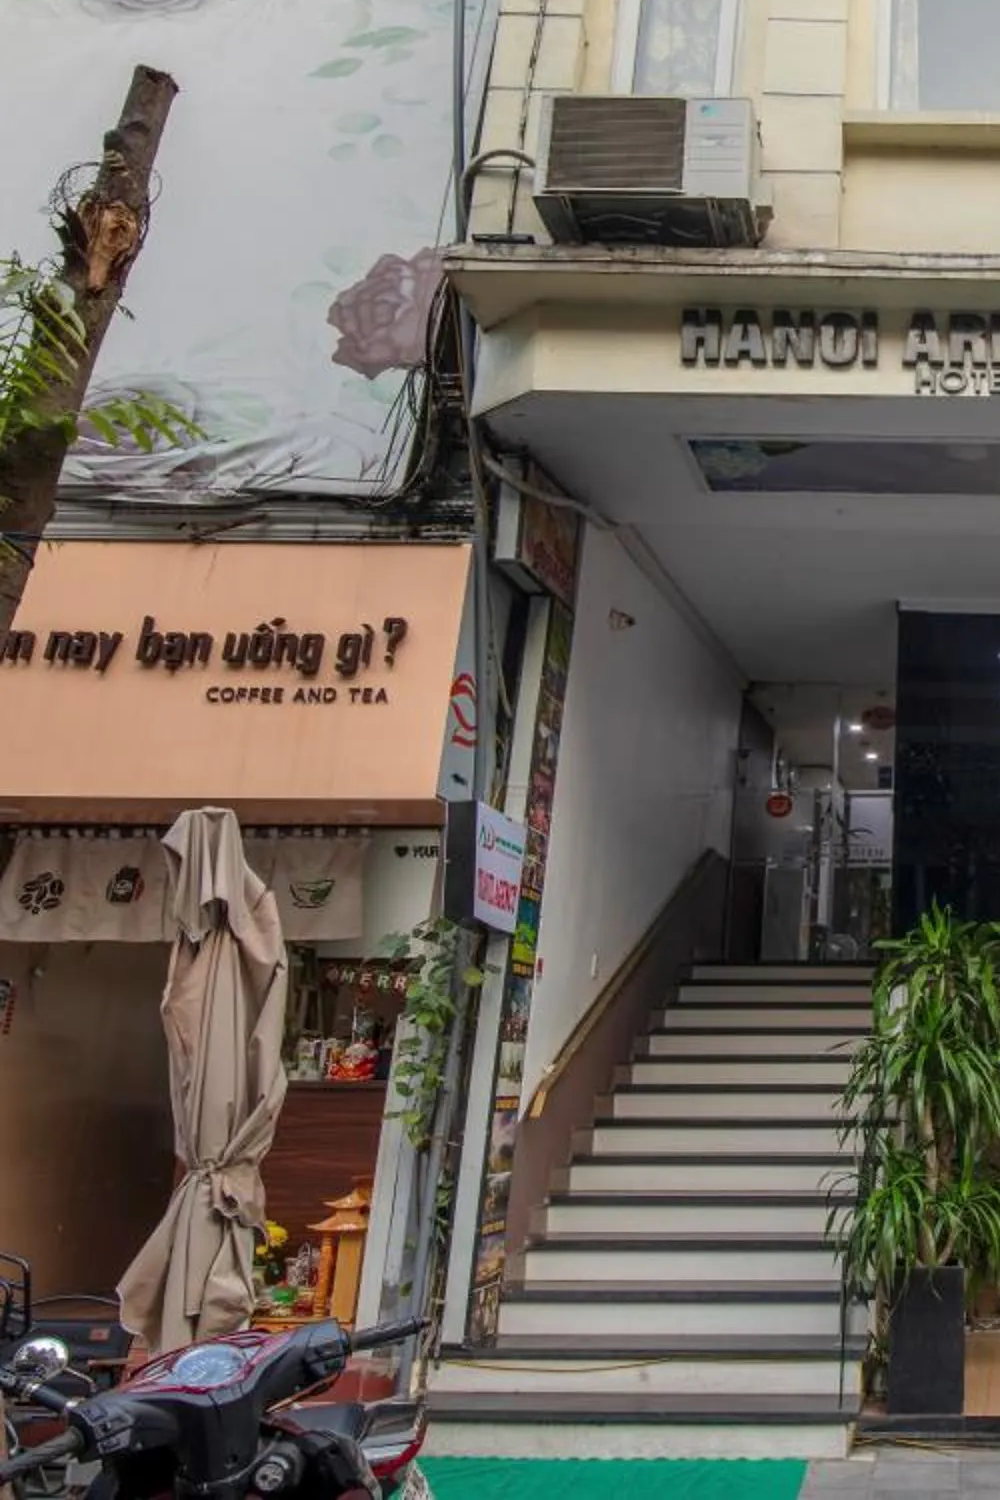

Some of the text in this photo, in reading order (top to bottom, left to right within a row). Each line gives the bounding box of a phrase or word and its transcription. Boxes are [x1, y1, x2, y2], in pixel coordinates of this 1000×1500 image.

[681, 308, 879, 369] HANOI
[44, 630, 123, 674] nay
[136, 616, 212, 674] bạn
[221, 617, 325, 675] uống
[206, 686, 388, 704] COFFEE AND TEA
[340, 969, 407, 989] MERR
